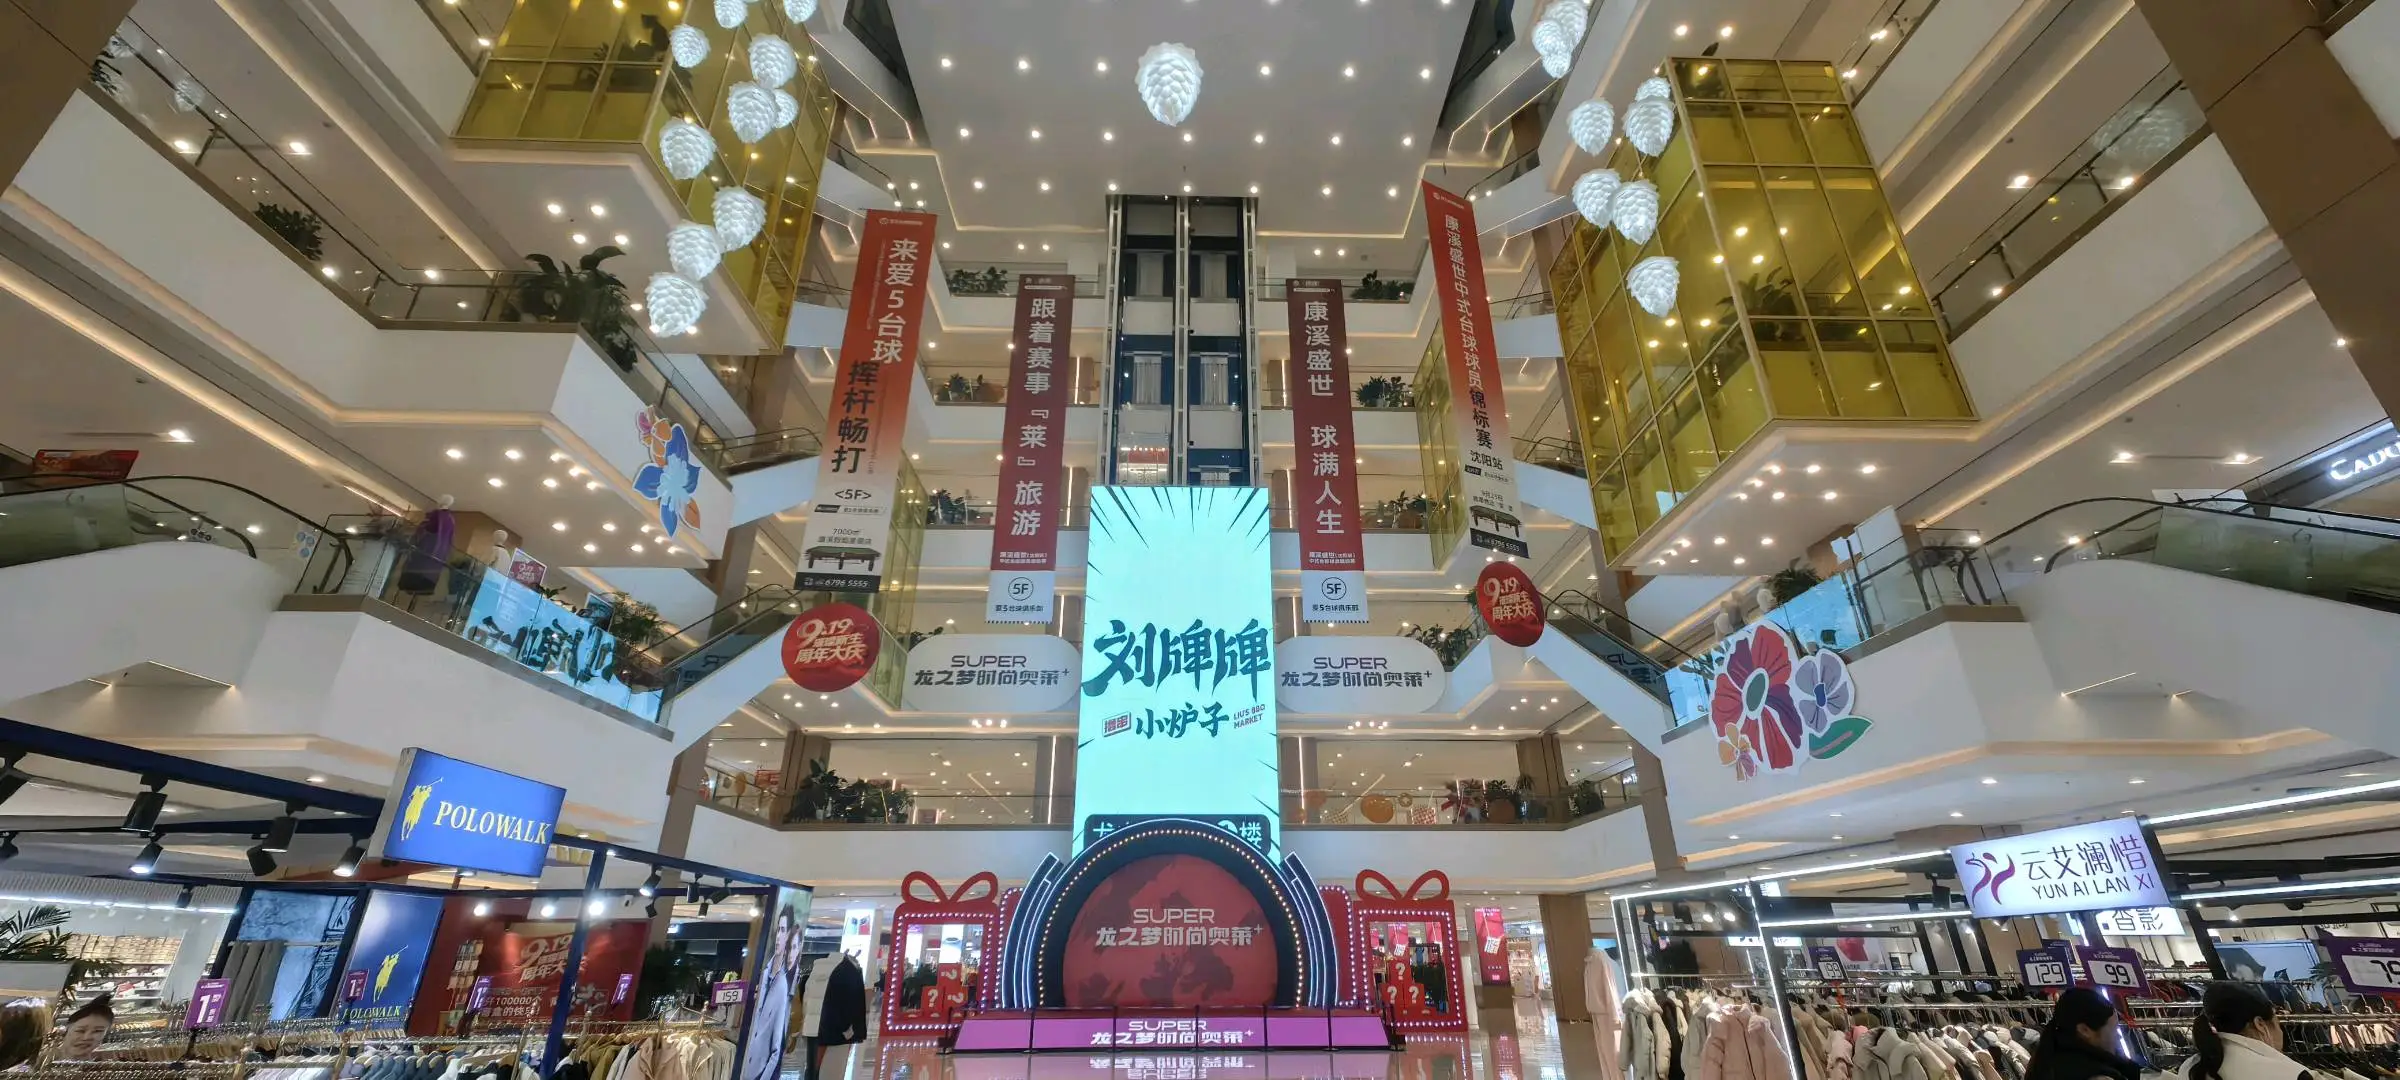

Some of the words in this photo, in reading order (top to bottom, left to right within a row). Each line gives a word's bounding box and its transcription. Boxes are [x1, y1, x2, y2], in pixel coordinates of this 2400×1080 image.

[870, 238, 919, 363] 来爱5台球
[1304, 301, 1334, 397] 康溪盛世
[832, 360, 880, 473] 挥杆畅打
[1470, 450, 1503, 470] 沈阳站
[1311, 424, 1345, 534] 球满人生
[1013, 583, 1029, 594] 5F
[1326, 583, 1342, 594] 5F
[1493, 601, 1537, 622] 周年大庆
[797, 619, 853, 647] 9.19
[794, 643, 867, 664] 周年大庆
[951, 655, 1027, 667] SUPER
[1081, 618, 1271, 702] 刘牌牌
[1313, 656, 1388, 669] SUPER
[1135, 701, 1230, 739] 小炉子
[1233, 712, 1264, 729] MARKET
[433, 800, 552, 845] POLOWALK
[2020, 834, 2147, 880] 云艾澜惜
[2031, 883, 2068, 900] YUN
[2073, 880, 2091, 896] AI
[2093, 876, 2131, 894] LAN
[2134, 873, 2155, 890] XI
[1133, 908, 1215, 924] SUPER
[2035, 963, 2064, 983] 129
[2105, 964, 2131, 984] 99
[722, 991, 738, 1001] 159
[1128, 1020, 1207, 1031] SUPER
